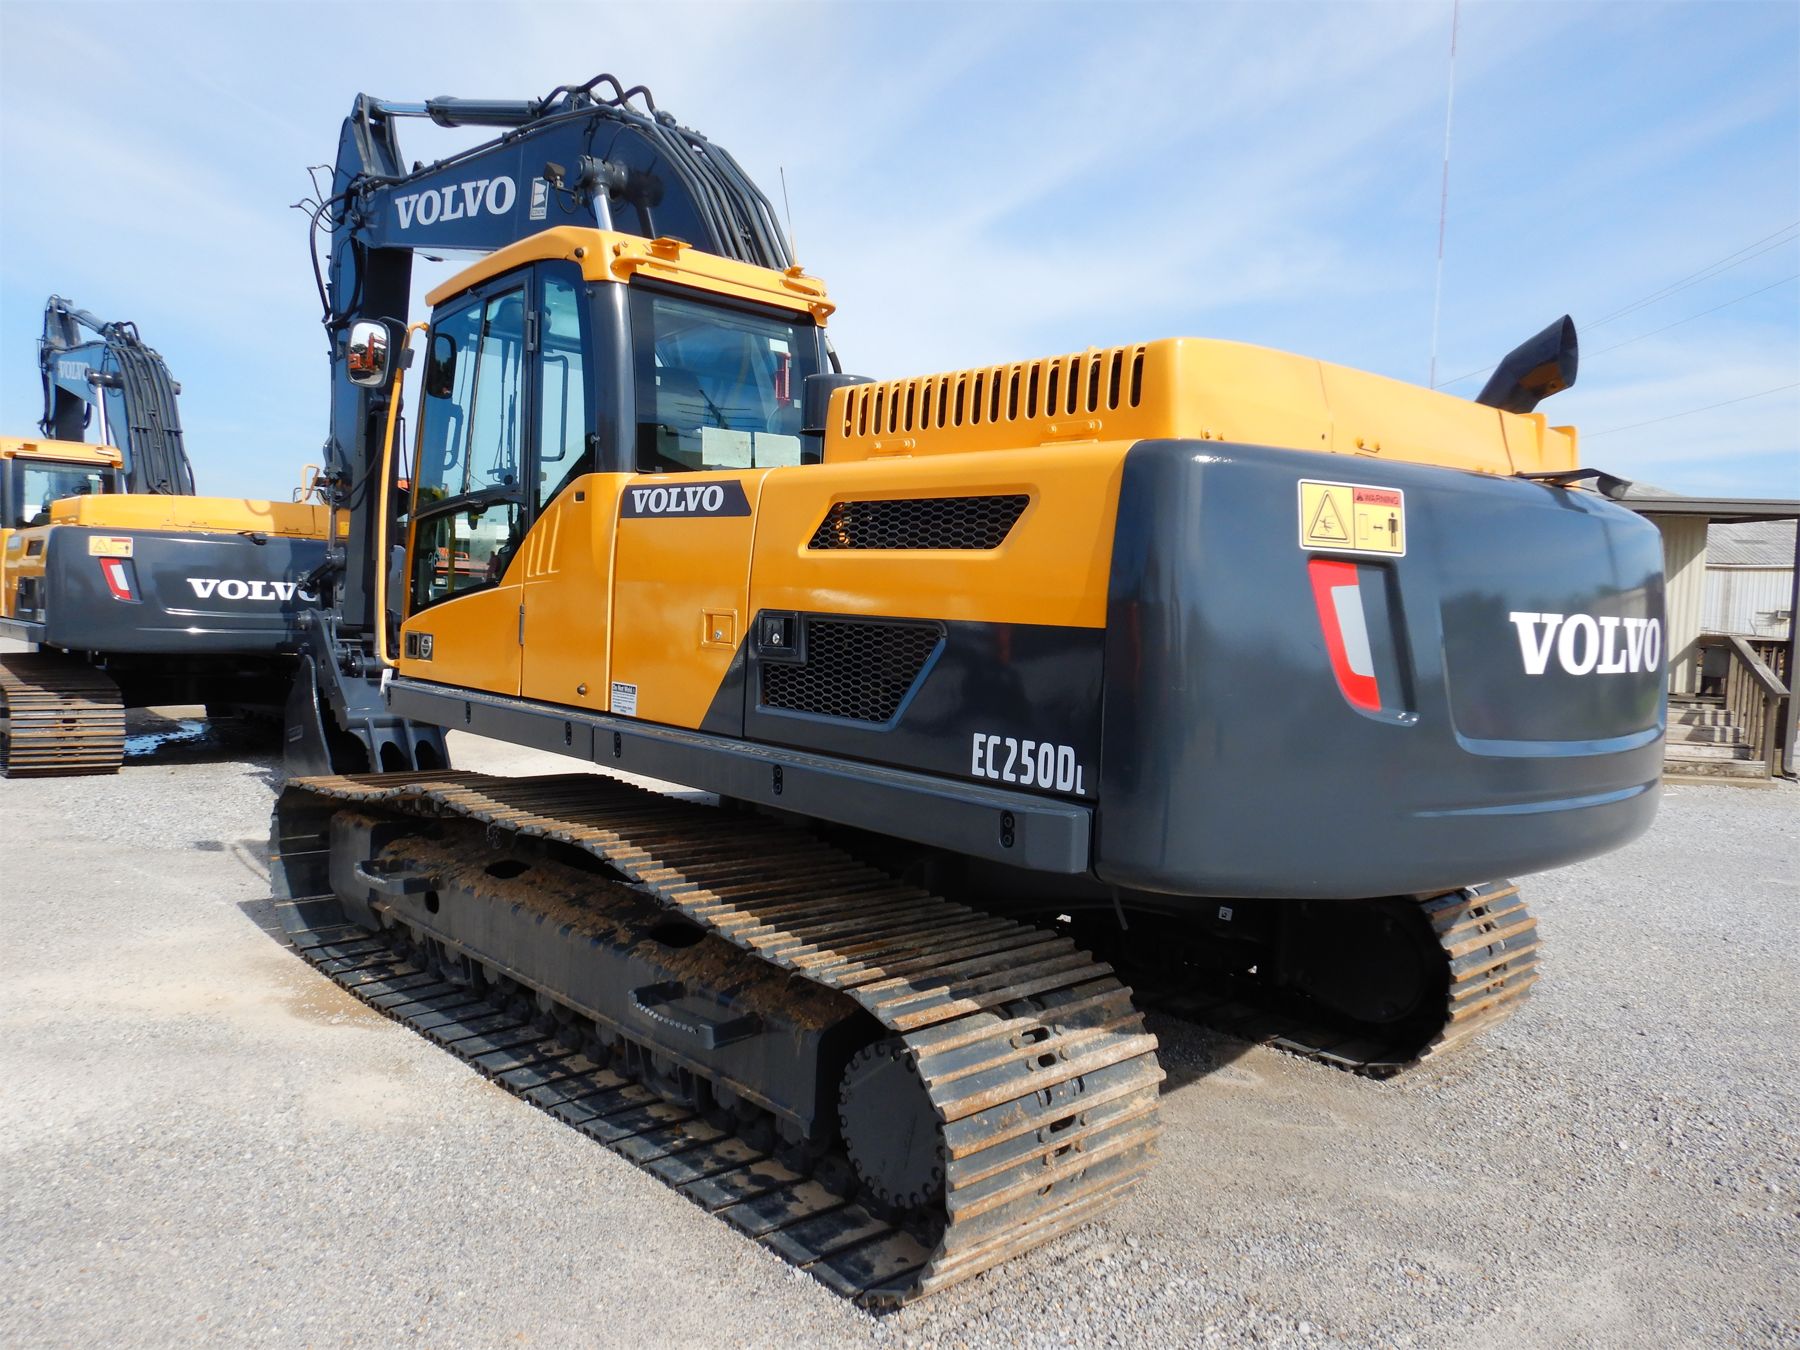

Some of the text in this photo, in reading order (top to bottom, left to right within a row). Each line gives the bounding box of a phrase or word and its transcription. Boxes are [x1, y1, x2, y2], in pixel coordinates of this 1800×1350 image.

[395, 176, 516, 229] VOLVO
[632, 485, 724, 513] VOLVO
[1364, 494, 1399, 505] WARNING
[1509, 611, 1661, 676] VOLVO
[971, 732, 1086, 795] EC250DL
